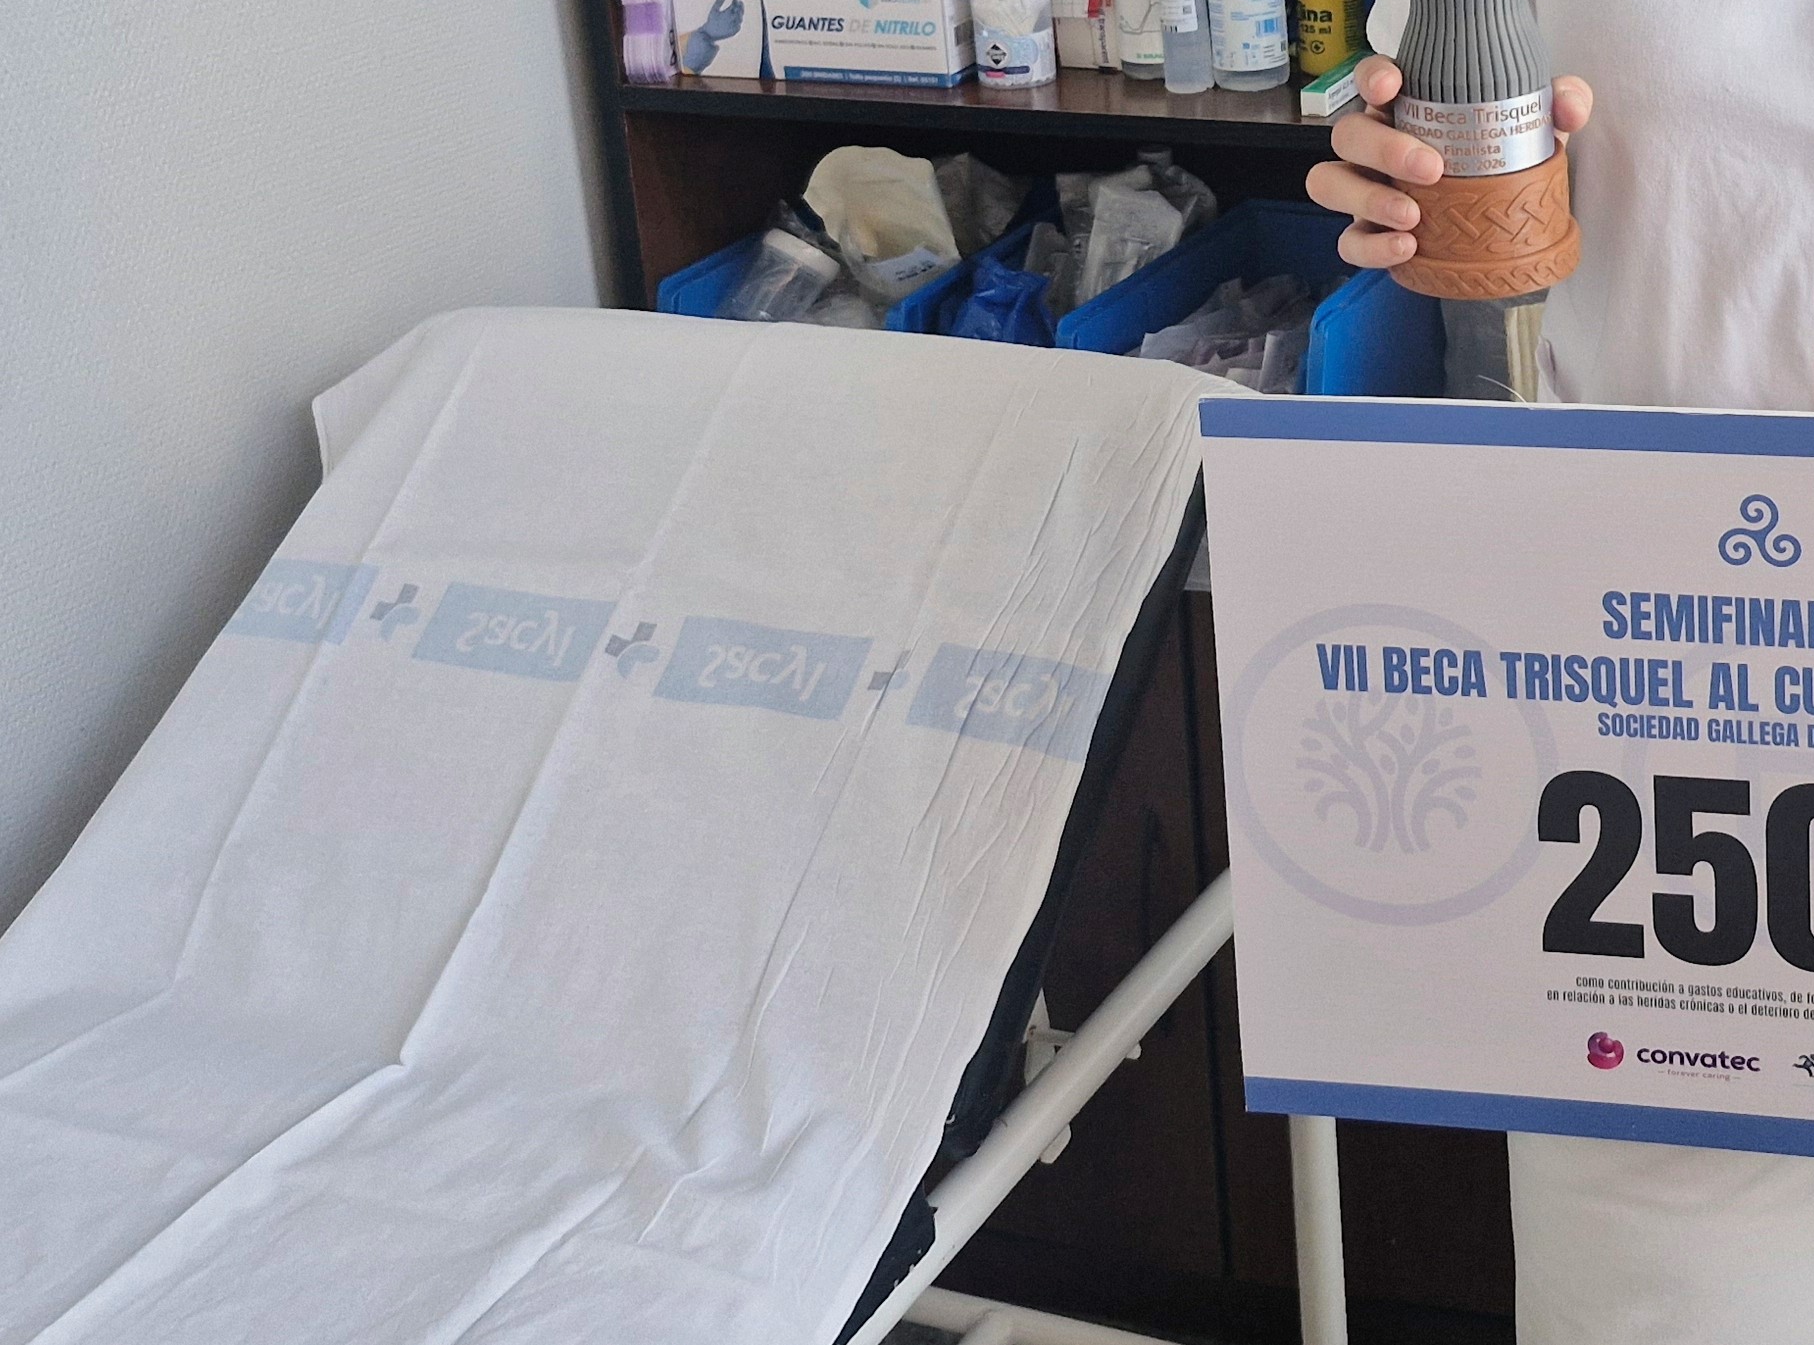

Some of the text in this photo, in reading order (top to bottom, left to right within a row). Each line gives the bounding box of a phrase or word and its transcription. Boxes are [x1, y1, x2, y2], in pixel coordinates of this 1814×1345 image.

[771, 15, 936, 36] GUANTES DE NITRILO
[1403, 94, 1542, 125] VII Beca Trisquel
[1446, 126, 1507, 141] GALLEGA
[1444, 143, 1502, 157] Finalista
[1445, 158, 1506, 174] igo 2026
[1316, 643, 1369, 692] VII
[1382, 646, 1487, 697] BECA
[1500, 651, 1694, 708] TRISQUEL
[1708, 662, 1759, 712] AL
[1598, 712, 1699, 741] SOCIEDAD
[1707, 718, 1800, 747] GALLEGA
[1576, 976, 1604, 989] como
[1608, 977, 1674, 994] contribución
[1678, 983, 1685, 994] a
[1688, 984, 1723, 998] gastos
[1726, 987, 1786, 1004] educativos,
[1790, 991, 1803, 1003] de
[1547, 989, 1559, 1001] en
[1563, 989, 1605, 1004] relación
[1609, 994, 1615, 1005] a
[1618, 993, 1634, 1007] las
[1637, 996, 1676, 1010] heridas
[1679, 997, 1725, 1014] crónicas
[1728, 1003, 1734, 1014] o
[1738, 1002, 1747, 1015] el
[1751, 1003, 1800, 1019] deterioro
[1637, 1046, 1761, 1072] convatec
[1667, 1069, 1731, 1082] forever caring
